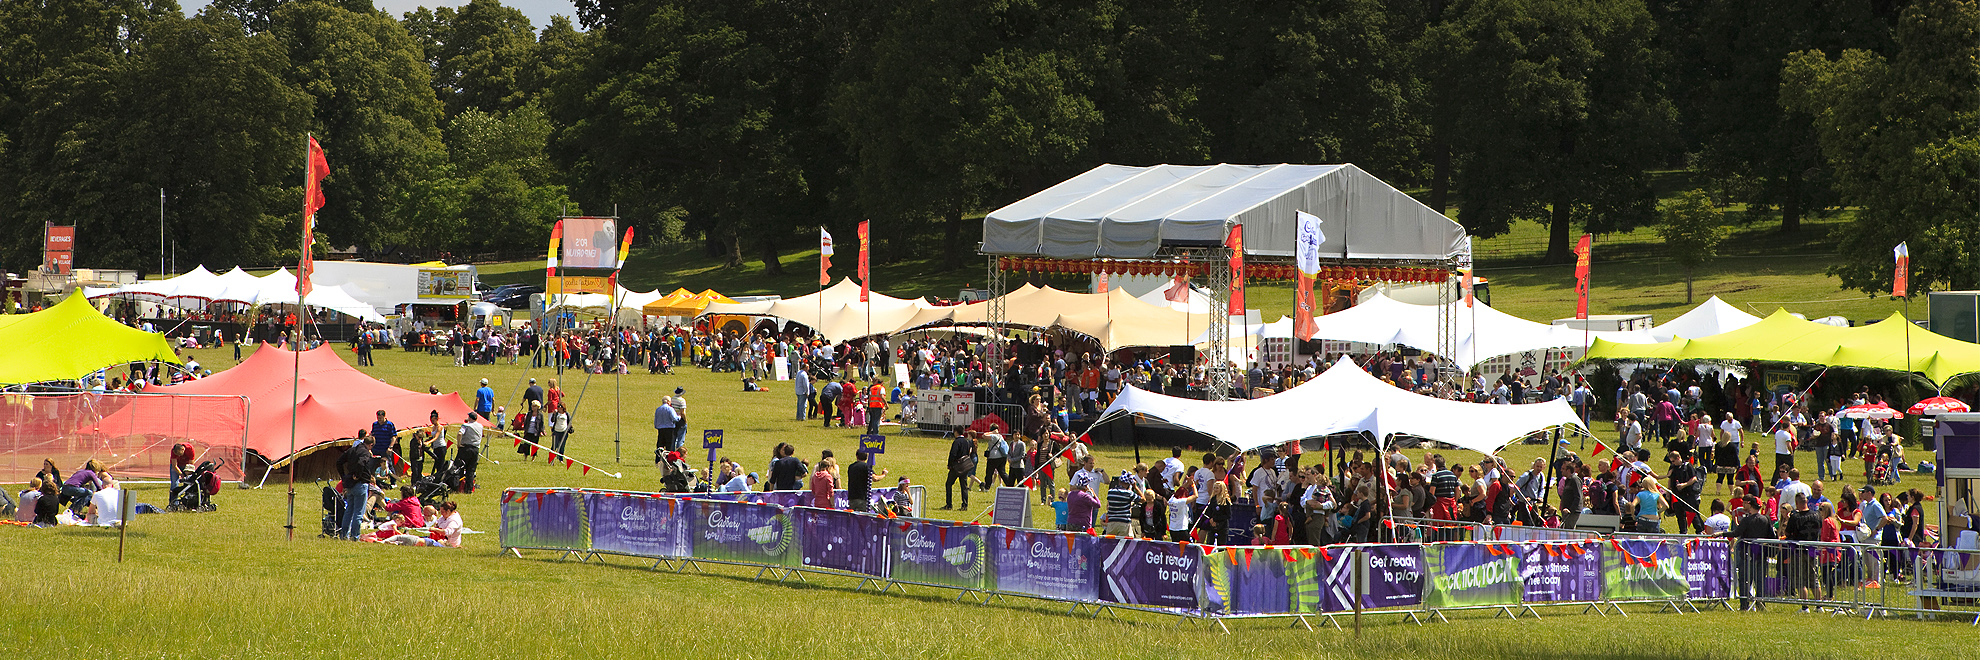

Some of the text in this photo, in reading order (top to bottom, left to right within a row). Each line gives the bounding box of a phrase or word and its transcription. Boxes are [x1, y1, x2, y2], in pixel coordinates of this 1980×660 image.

[1779, 374, 1799, 384] NATUR
[708, 510, 741, 531] Cadbury
[905, 529, 936, 551] Cadbury
[1031, 541, 1060, 561] Cadbury
[1146, 551, 1193, 570] Get ready
[1370, 554, 1416, 569] Get ready
[1159, 567, 1169, 580] to
[1384, 569, 1419, 584] to play
